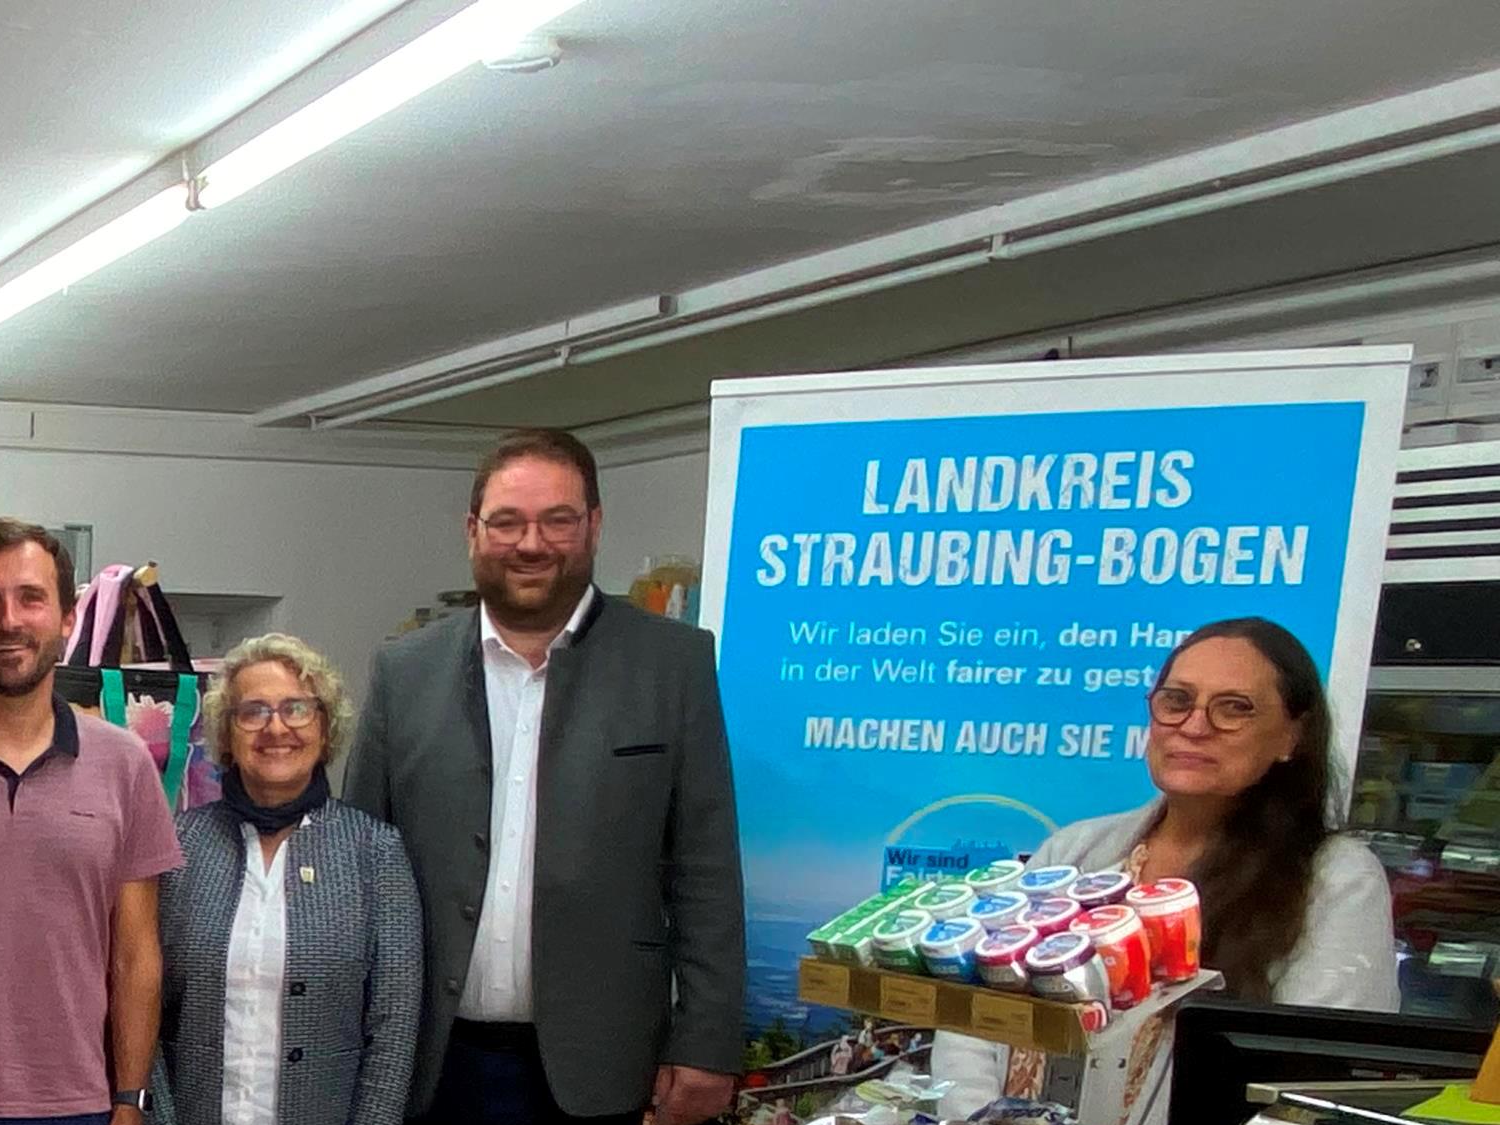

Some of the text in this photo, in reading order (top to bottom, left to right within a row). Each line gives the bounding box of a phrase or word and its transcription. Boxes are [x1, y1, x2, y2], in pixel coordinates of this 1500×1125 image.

[863, 450, 1194, 515] LANDKREIS
[757, 526, 1309, 587] STRAUBING-BOGEN
[789, 622, 1193, 650] Wir laden Sie ein, den Han
[781, 661, 1157, 695] in der Welt fairer zu gest
[804, 717, 945, 752] MACHEN
[956, 720, 1046, 755] AUCH
[1059, 722, 1113, 757] SIE
[886, 847, 970, 869] Wir sind
